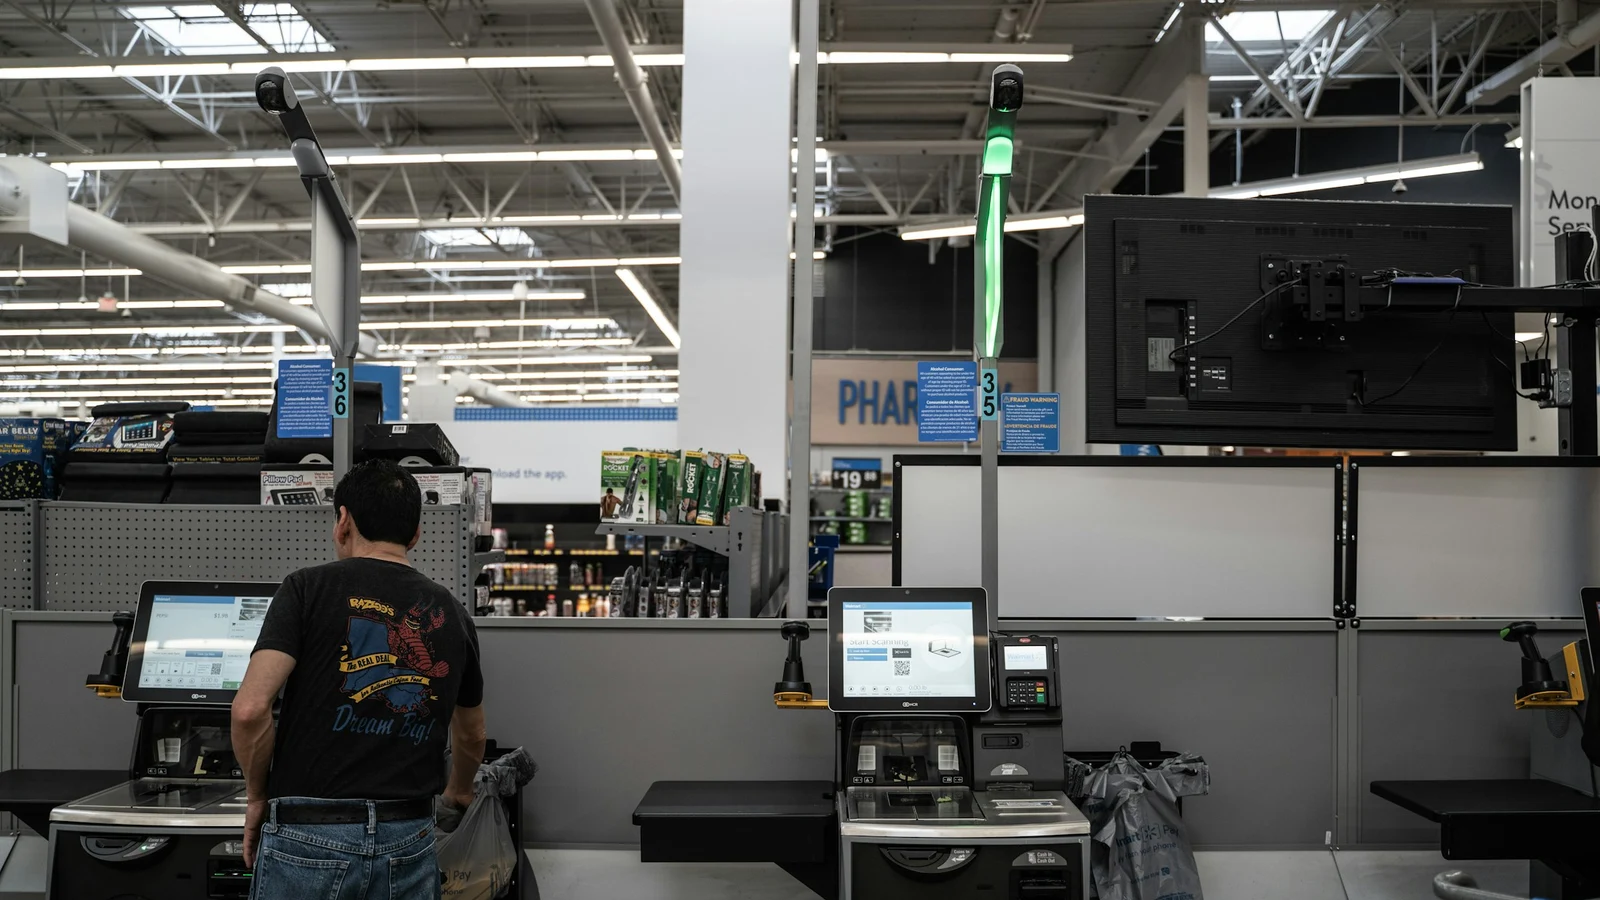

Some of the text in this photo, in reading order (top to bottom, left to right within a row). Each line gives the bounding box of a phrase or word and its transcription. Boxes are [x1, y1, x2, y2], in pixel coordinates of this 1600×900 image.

[1549, 189, 1600, 210] Mon
[335, 372, 346, 416] 36
[983, 372, 995, 417] 35
[12, 427, 38, 435] BELLY
[263, 474, 303, 483] Pillow Pad
[524, 469, 541, 479] the
[544, 473, 568, 481] app.
[687, 463, 696, 494] ROCKET
[850, 638, 909, 646] Start Scanning
[347, 654, 390, 671] The REAL DEAL
[1007, 653, 1034, 661] Walmart
[360, 690, 369, 699] for
[370, 679, 393, 693] Authentic
[332, 704, 436, 746] Dream Big!
[1163, 825, 1179, 836] Pay
[1153, 842, 1177, 853] phone
[453, 870, 472, 882] Pay
